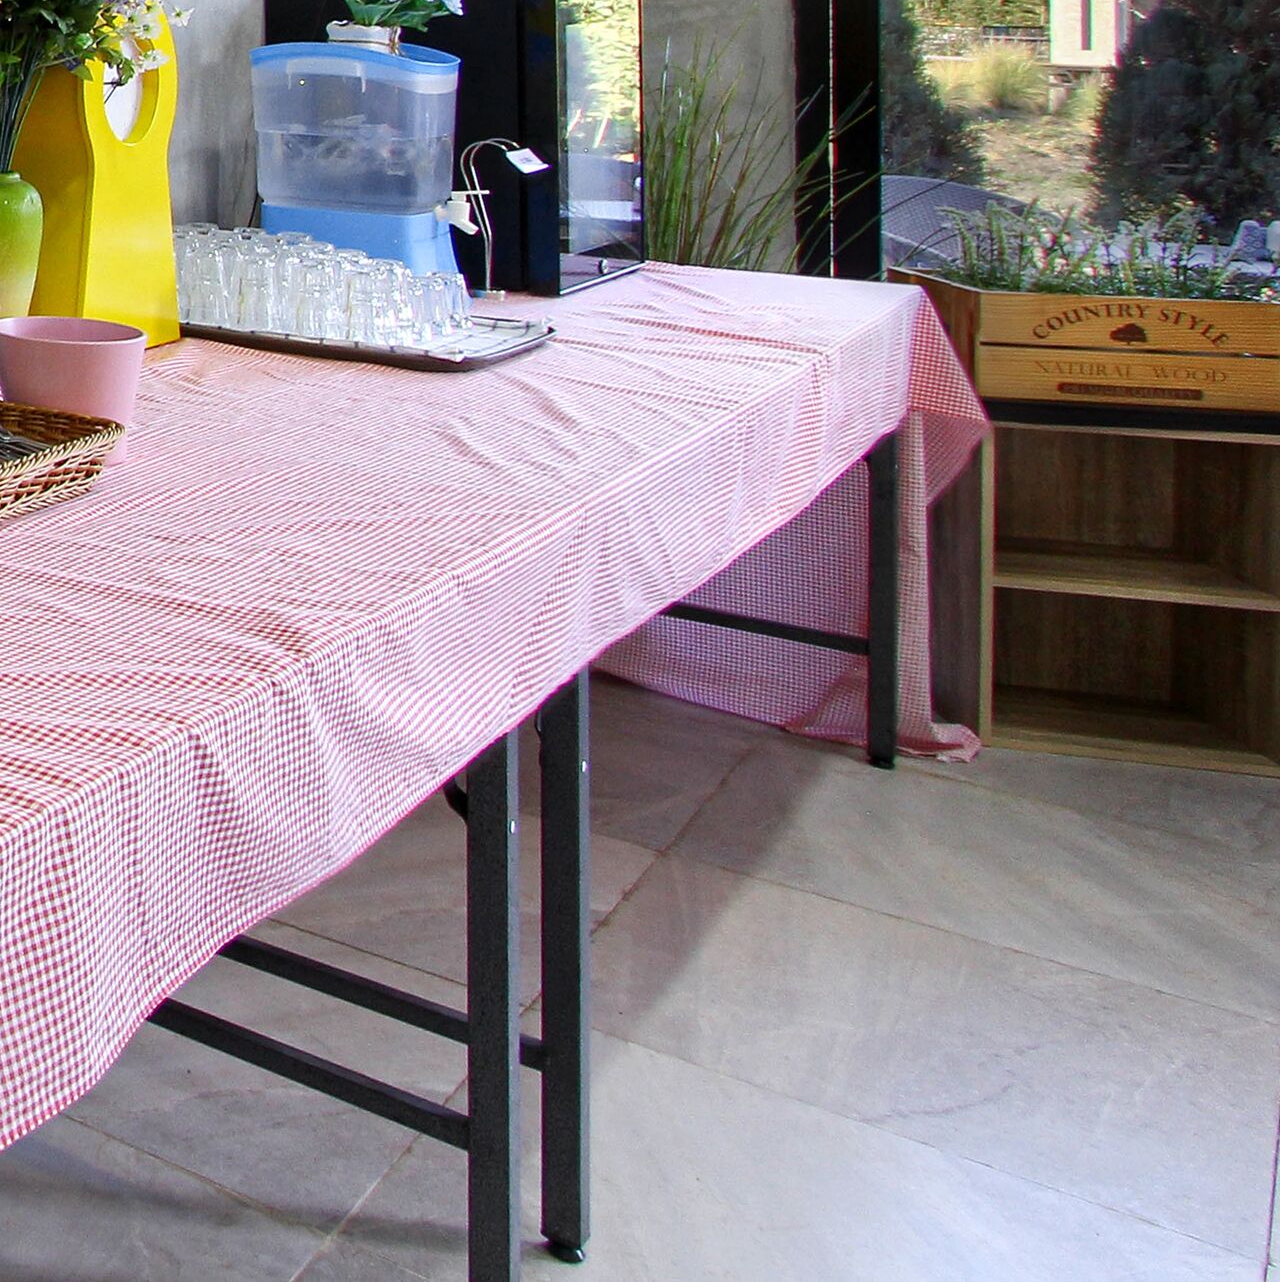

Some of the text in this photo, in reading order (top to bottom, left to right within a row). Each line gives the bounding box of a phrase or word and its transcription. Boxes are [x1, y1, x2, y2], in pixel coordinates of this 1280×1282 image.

[1032, 302, 1229, 346] COUNTRY STYLE
[1035, 361, 1227, 382] NATURAL WOOD
